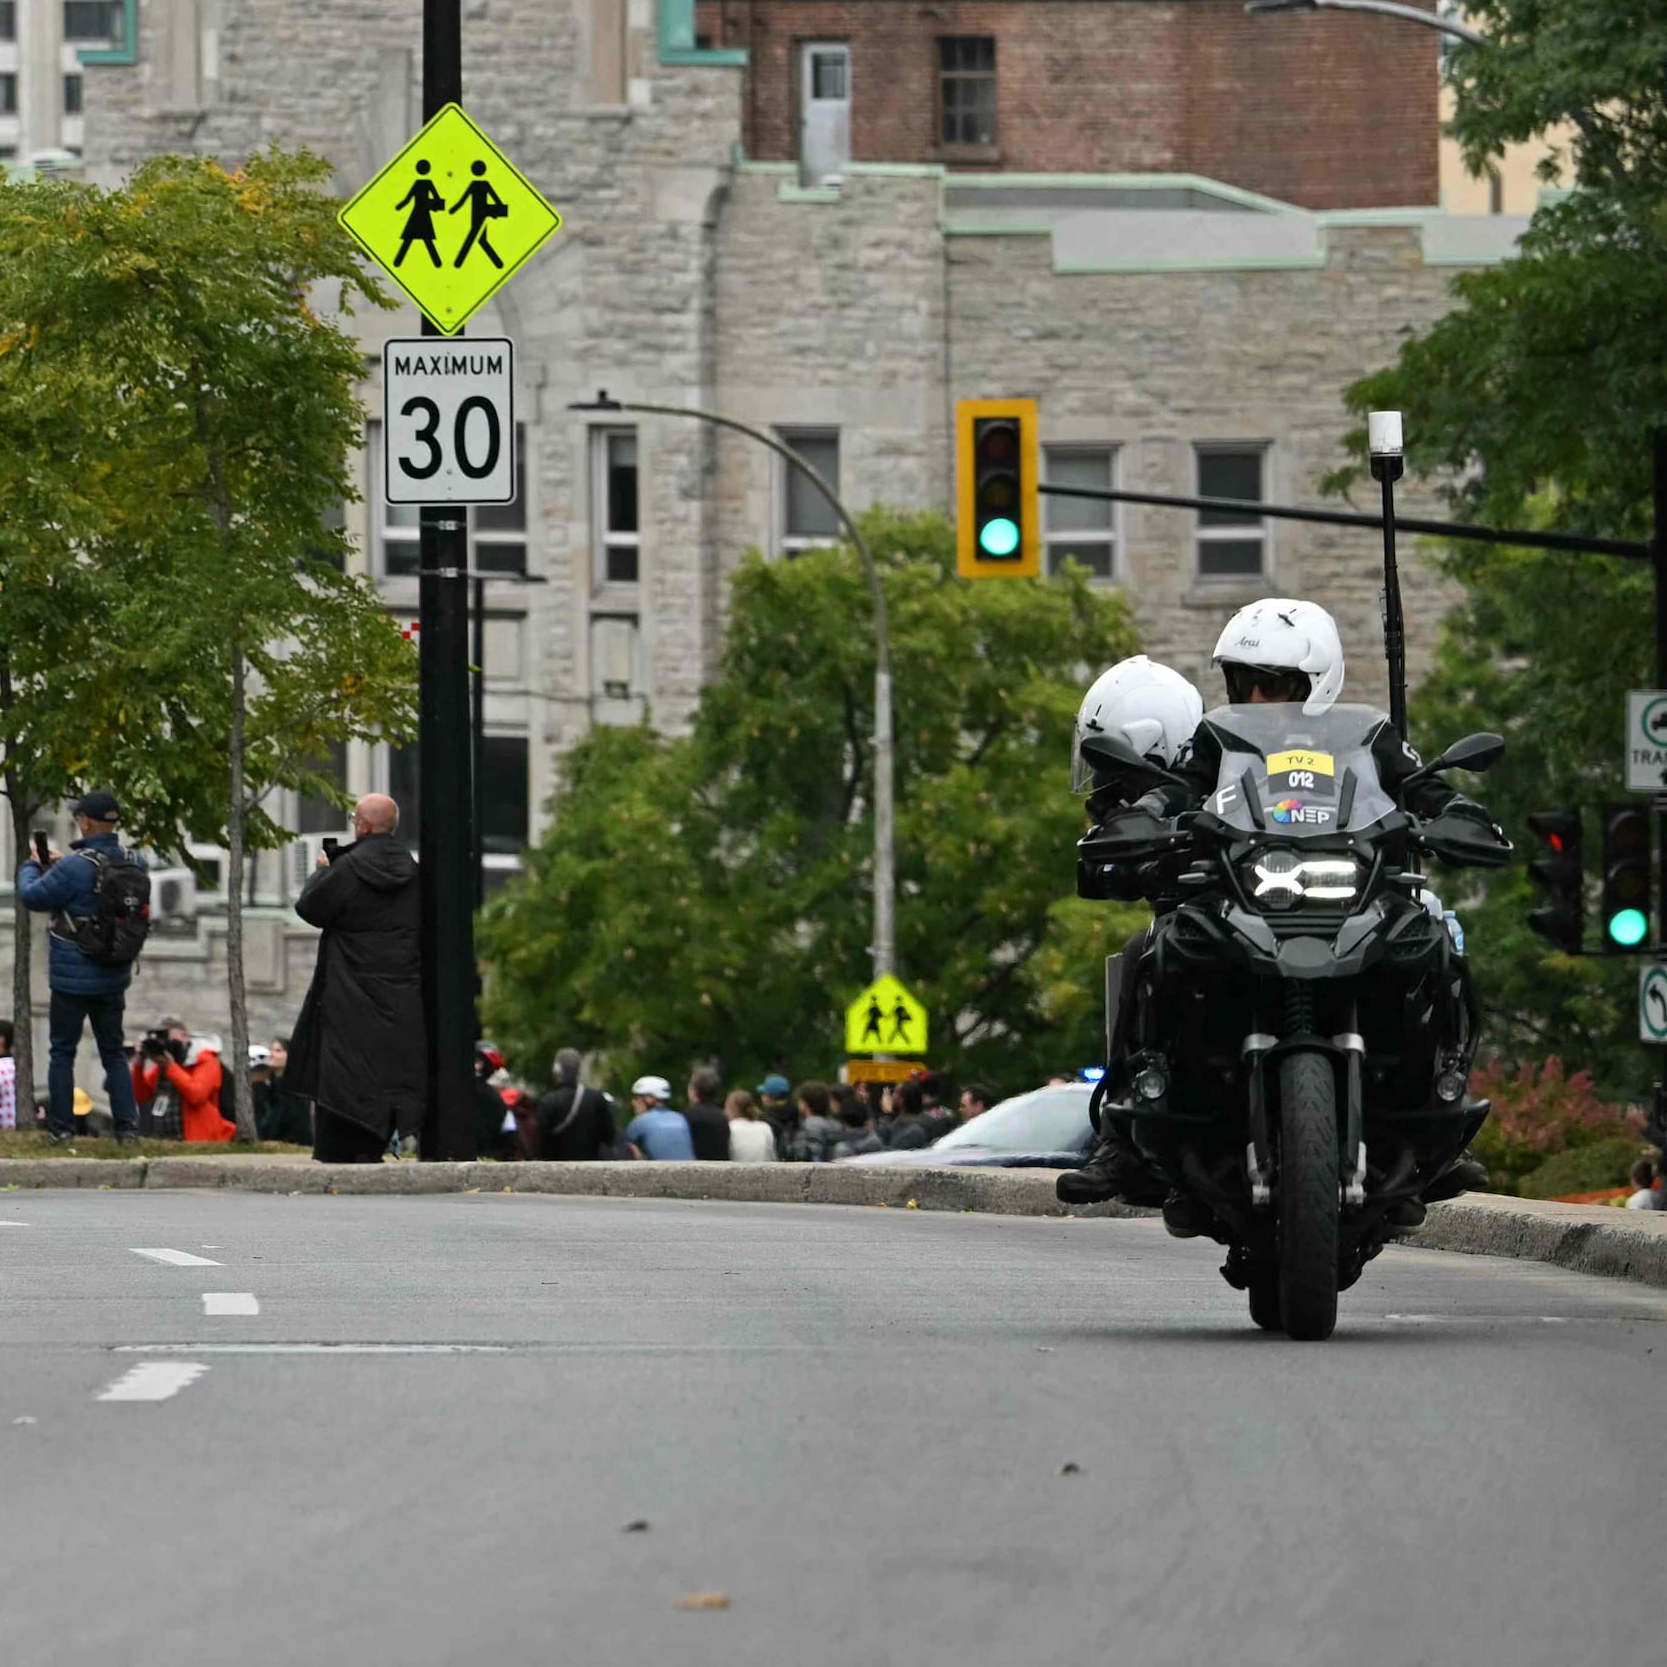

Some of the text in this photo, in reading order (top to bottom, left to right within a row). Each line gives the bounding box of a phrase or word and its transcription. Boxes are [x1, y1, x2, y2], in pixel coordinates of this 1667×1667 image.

[395, 355, 503, 376] MAXIMUM
[398, 396, 501, 480] 30
[1287, 756, 1316, 766] TV 2
[1633, 749, 1667, 765] TRA
[1288, 770, 1315, 789] 012
[1290, 808, 1331, 824] NEP
